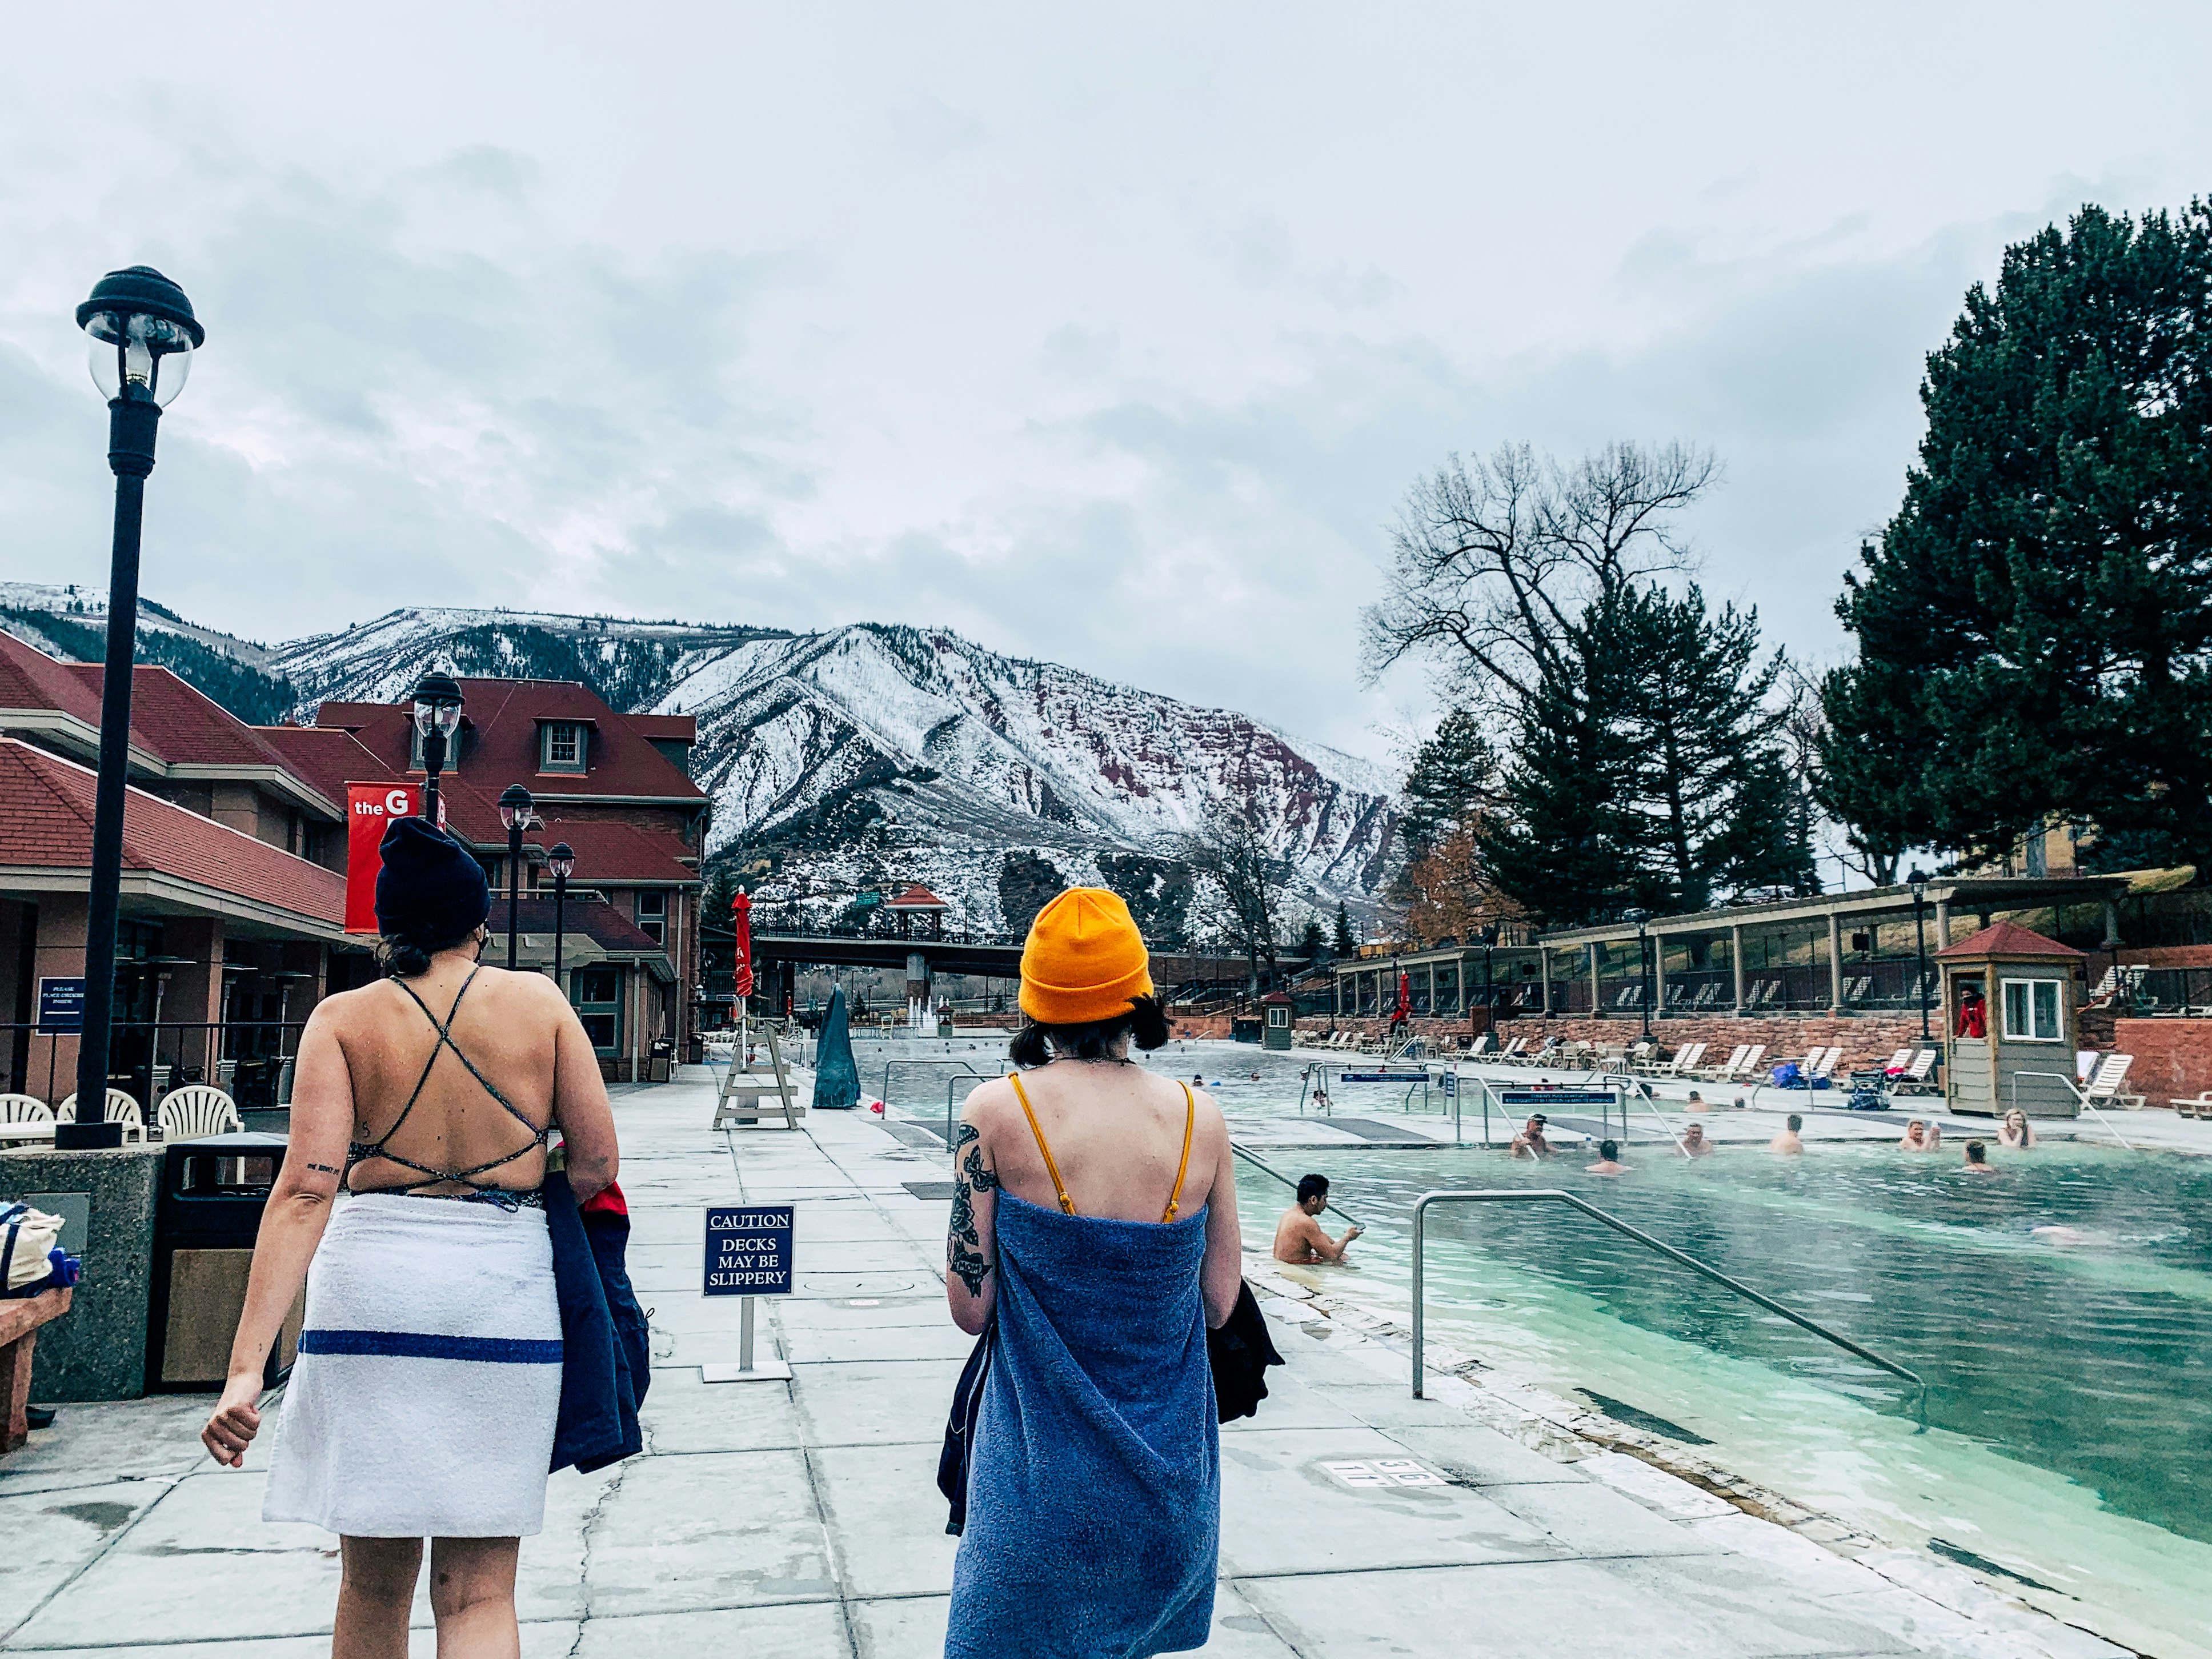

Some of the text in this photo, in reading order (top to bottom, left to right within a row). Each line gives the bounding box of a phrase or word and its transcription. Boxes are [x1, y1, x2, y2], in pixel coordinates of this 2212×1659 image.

[354, 789, 409, 816] the G
[710, 1214, 790, 1228] CAUTION
[722, 1238, 777, 1252] DECKS
[718, 1255, 779, 1269] MAY BE
[958, 1261, 980, 1273] MOM
[709, 1271, 787, 1286] SLIPPERY
